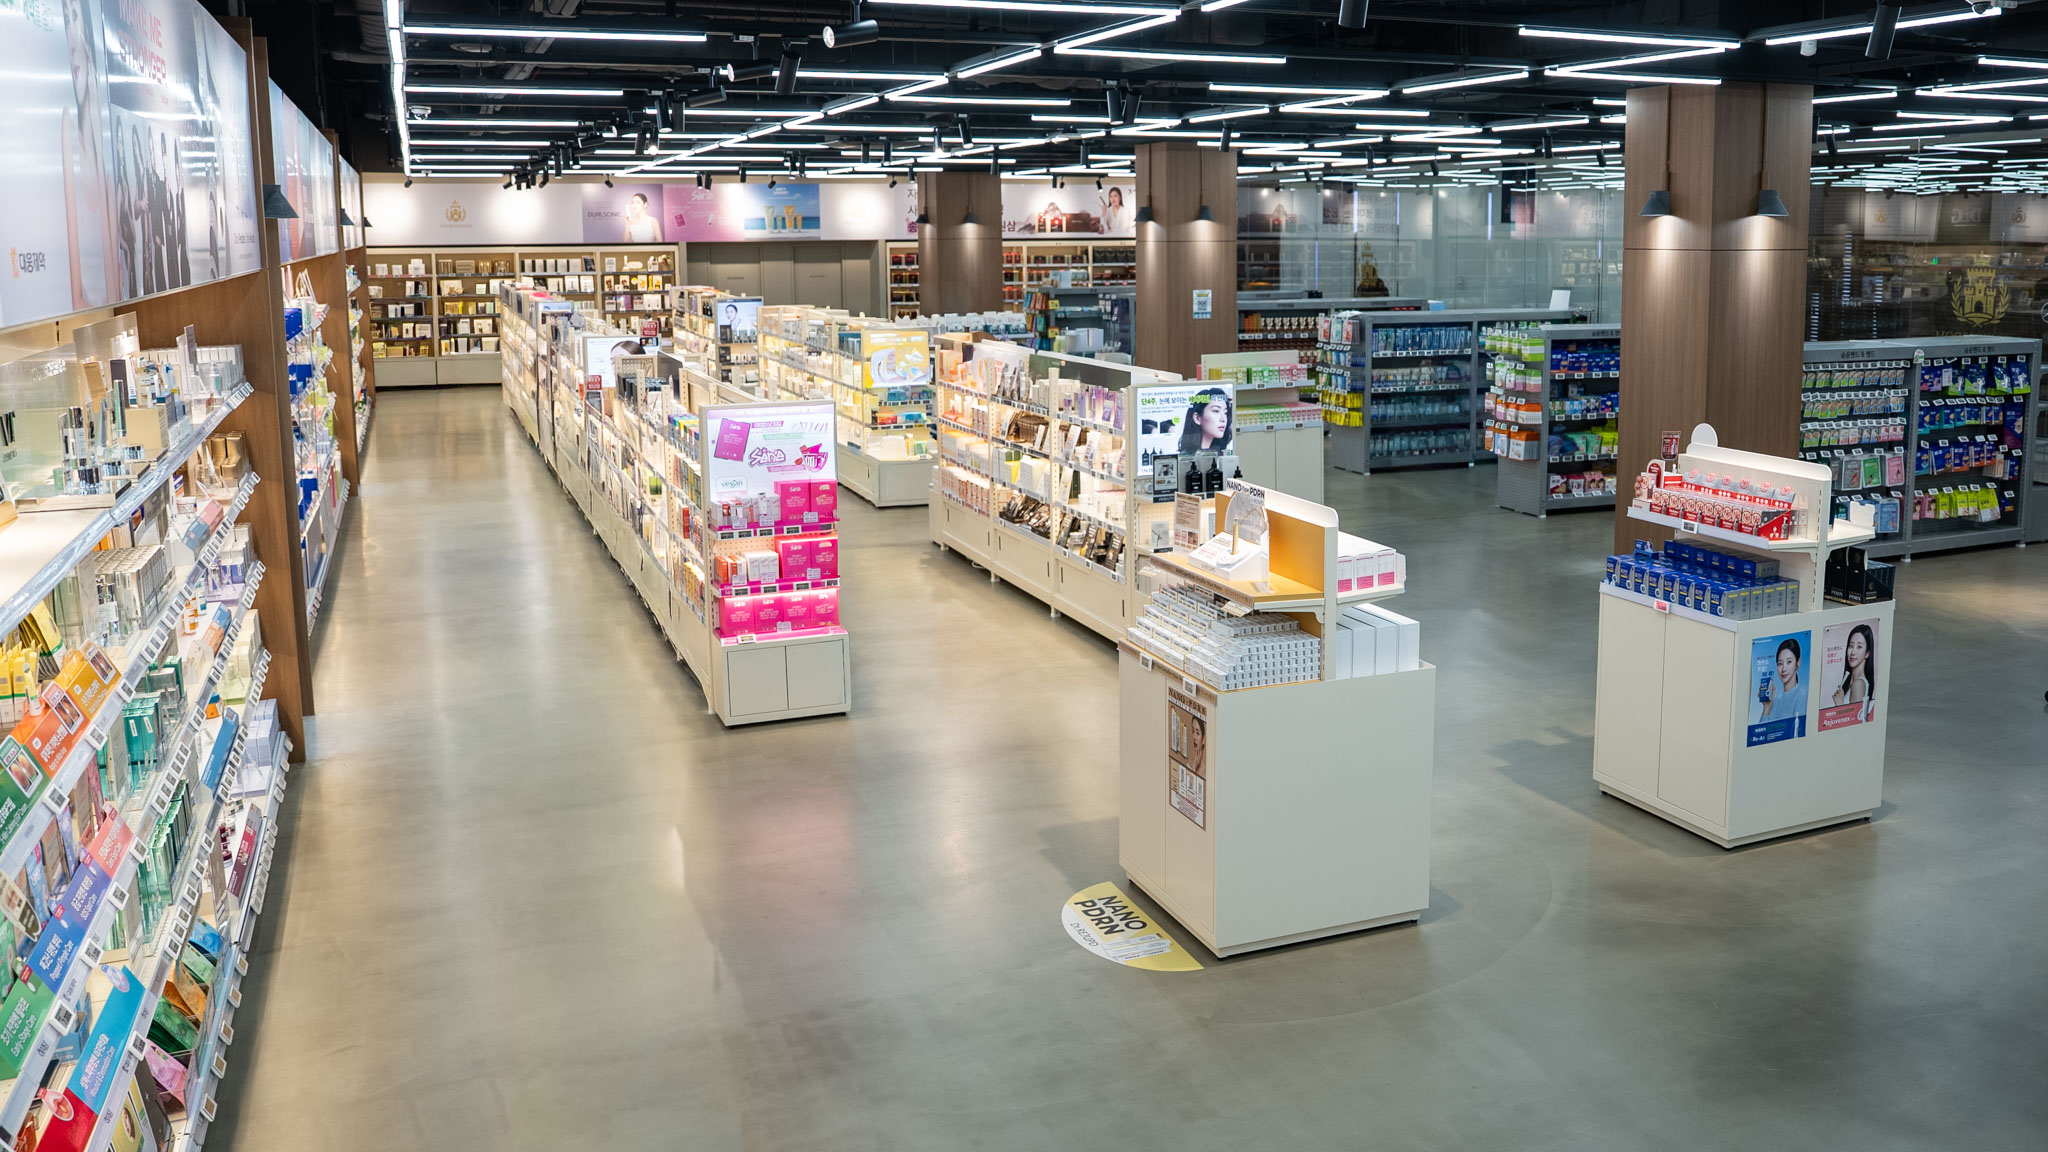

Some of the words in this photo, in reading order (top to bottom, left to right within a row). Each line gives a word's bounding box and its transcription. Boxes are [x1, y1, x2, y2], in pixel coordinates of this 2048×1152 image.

[119, 0, 146, 36] MAKE
[149, 12, 162, 47] ME
[119, 29, 167, 87] STRONGER
[18, 251, 45, 272] 대웅제약
[1171, 396, 1187, 404] 보이는
[721, 480, 743, 488] vegan
[1227, 481, 1241, 492] NANO
[1249, 487, 1265, 499] PDRN
[1824, 717, 1850, 727] Rejuvenex
[1073, 899, 1126, 935] PDRN
[1097, 895, 1147, 929] NANO
[5, 1012, 22, 1034] 진정엔
[11, 1024, 32, 1057] Early-Stage
[25, 1013, 36, 1028] Care
